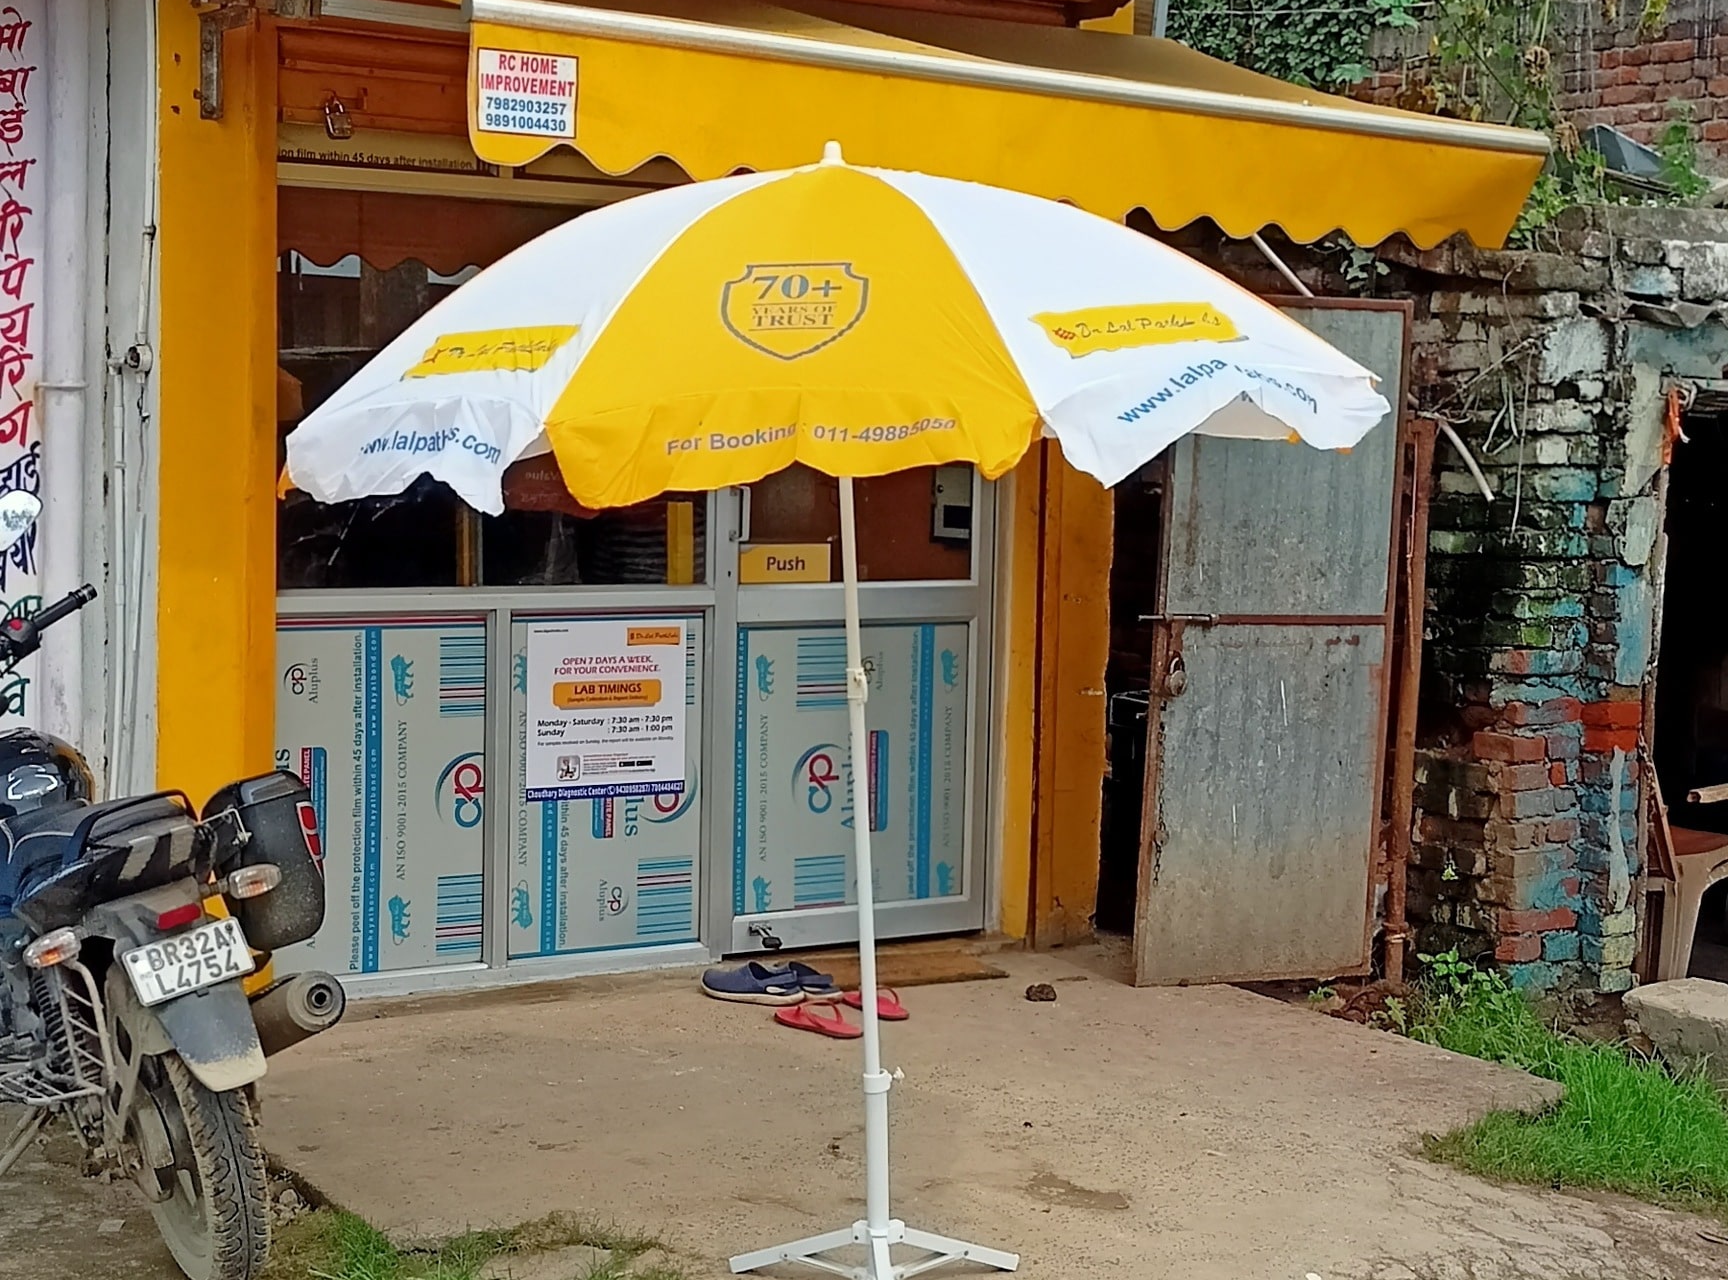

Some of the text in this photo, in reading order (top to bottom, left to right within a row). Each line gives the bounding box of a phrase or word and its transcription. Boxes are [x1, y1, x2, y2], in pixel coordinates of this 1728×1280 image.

[499, 54, 558, 75] RC HOME
[481, 73, 574, 97] IMPROVEMENT
[485, 96, 567, 116] 7982903257
[485, 113, 566, 132] 9891004430
[752, 273, 842, 300] 70+
[752, 305, 807, 315] YEARS
[752, 314, 834, 327] TRUST
[667, 436, 702, 455] For
[766, 556, 805, 571] Push
[554, 666, 572, 675] FOR
[574, 666, 597, 675] YOUR
[562, 657, 587, 666] OPEN
[595, 656, 617, 664] DAYS
[618, 656, 626, 664] A
[308, 658, 321, 704] Aluplus
[574, 683, 642, 695] LAB TIMINGS
[537, 718, 568, 728] Monday
[572, 717, 605, 727] Saturday
[661, 716, 673, 724] pm
[537, 729, 565, 737] Sunday
[661, 725, 673, 733] pm
[760, 714, 768, 769] COMPANY
[350, 632, 364, 971] Please peel off the protection film within 45 days after installation.
[397, 720, 407, 881] AN ISO 9001-2015 COMPANY
[527, 790, 557, 799] Choudhary
[558, 787, 587, 798] Diagnostic
[588, 787, 607, 796] Center
[604, 816, 612, 837] PANEL
[518, 810, 527, 868] COMPANY
[760, 846, 767, 862] AN
[559, 801, 569, 949] ithin 45 days after installation.
[597, 879, 608, 922] Aluplus
[155, 949, 240, 995] L4754
